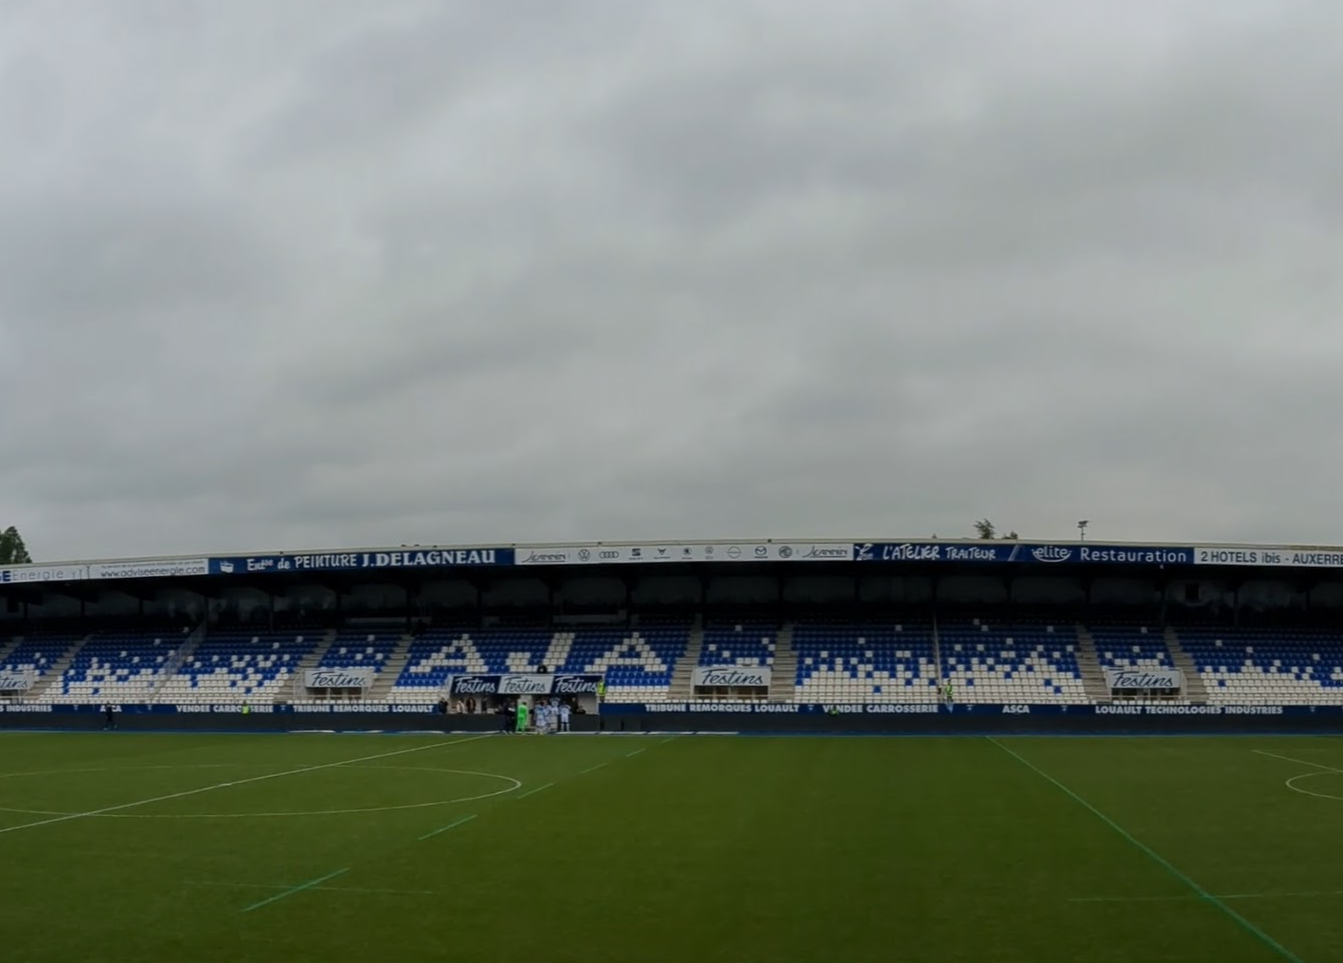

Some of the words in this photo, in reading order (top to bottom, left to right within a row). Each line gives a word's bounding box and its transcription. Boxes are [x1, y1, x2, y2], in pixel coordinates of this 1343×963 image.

[882, 544, 940, 561] L'ATELIER
[945, 546, 996, 561] TRAITEUR
[1081, 548, 1187, 563] Restauration
[1200, 551, 1208, 562] 2
[1211, 552, 1257, 563] HOTELS
[1261, 552, 1281, 564] ibis
[277, 557, 291, 570] de
[293, 553, 358, 569] PEINTURE
[361, 550, 496, 568] J.DELAGNEAU
[12, 569, 64, 582] Energie
[100, 566, 206, 579] www.adviseenergie.com
[311, 672, 366, 687] Festins
[702, 668, 763, 685] Festins
[1113, 671, 1173, 688] Festins
[454, 677, 495, 693] Festins
[503, 677, 546, 693] Festins
[554, 676, 597, 692] Festins
[6, 704, 52, 713] INDUSTRIES
[176, 704, 210, 713] VENDEE
[293, 704, 331, 712] TRIBUNE
[333, 704, 389, 712] REMORQUES
[392, 704, 433, 712] LOUAULT
[645, 704, 686, 712] TRIBUNE
[689, 704, 751, 712] REMORQUES
[754, 704, 799, 712] LOUAULT
[866, 704, 938, 713] CARROSSERIE
[1002, 705, 1029, 713] ASCA
[1095, 705, 1143, 714] LOUAULT
[1145, 705, 1222, 714] TECHNOLOGIES
[1224, 706, 1283, 714] INDUSTRIES
